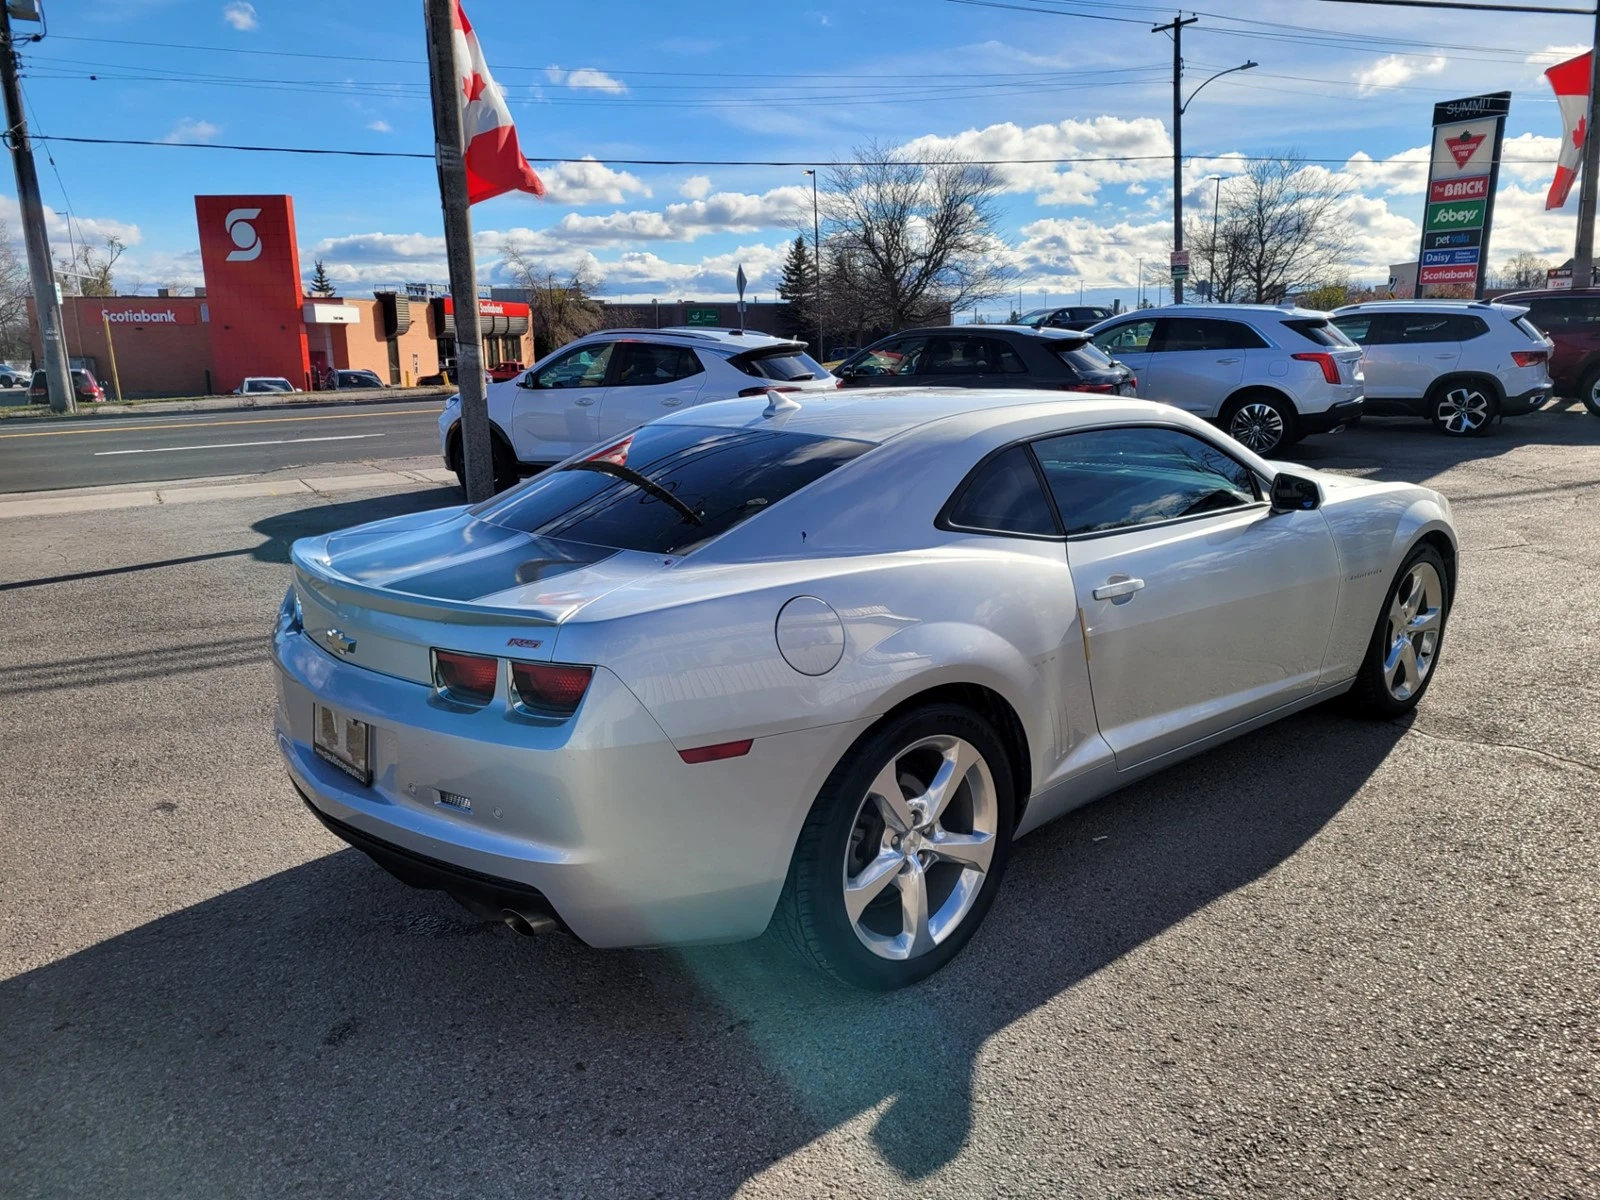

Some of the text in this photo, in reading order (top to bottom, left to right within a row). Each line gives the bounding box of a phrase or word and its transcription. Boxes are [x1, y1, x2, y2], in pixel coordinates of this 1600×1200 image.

[1446, 98, 1492, 115] SUMMIT
[1451, 143, 1477, 152] CANADIAN
[1458, 150, 1469, 158] TIRE
[1444, 180, 1484, 197] BRICK
[1433, 208, 1479, 224] Sobeys
[1425, 252, 1451, 263] Daisy
[1423, 269, 1475, 280] Scotiabank
[101, 309, 176, 322] Scotiabank
[507, 637, 544, 649] RS
